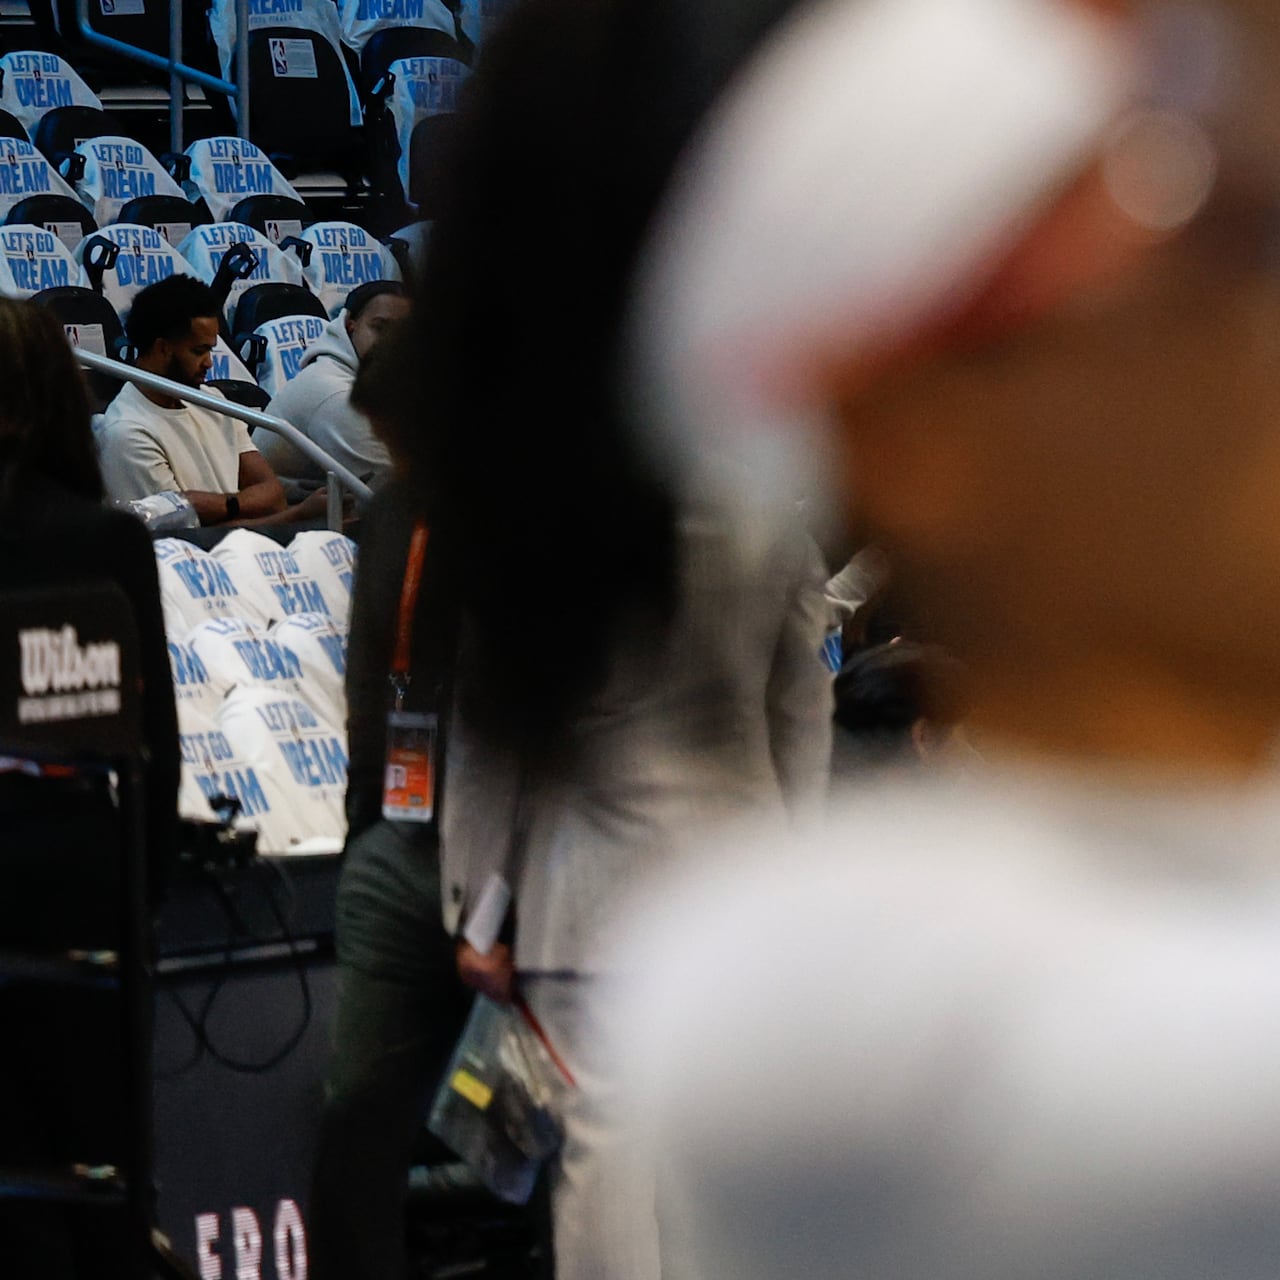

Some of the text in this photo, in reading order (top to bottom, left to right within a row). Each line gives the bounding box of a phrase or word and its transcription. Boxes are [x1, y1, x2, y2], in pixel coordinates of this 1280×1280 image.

[15, 78, 73, 107] DREAM
[241, 139, 258, 158] GO
[213, 162, 273, 193] DREAM
[314, 227, 366, 246] LET'S GO
[322, 253, 382, 284] DREAM
